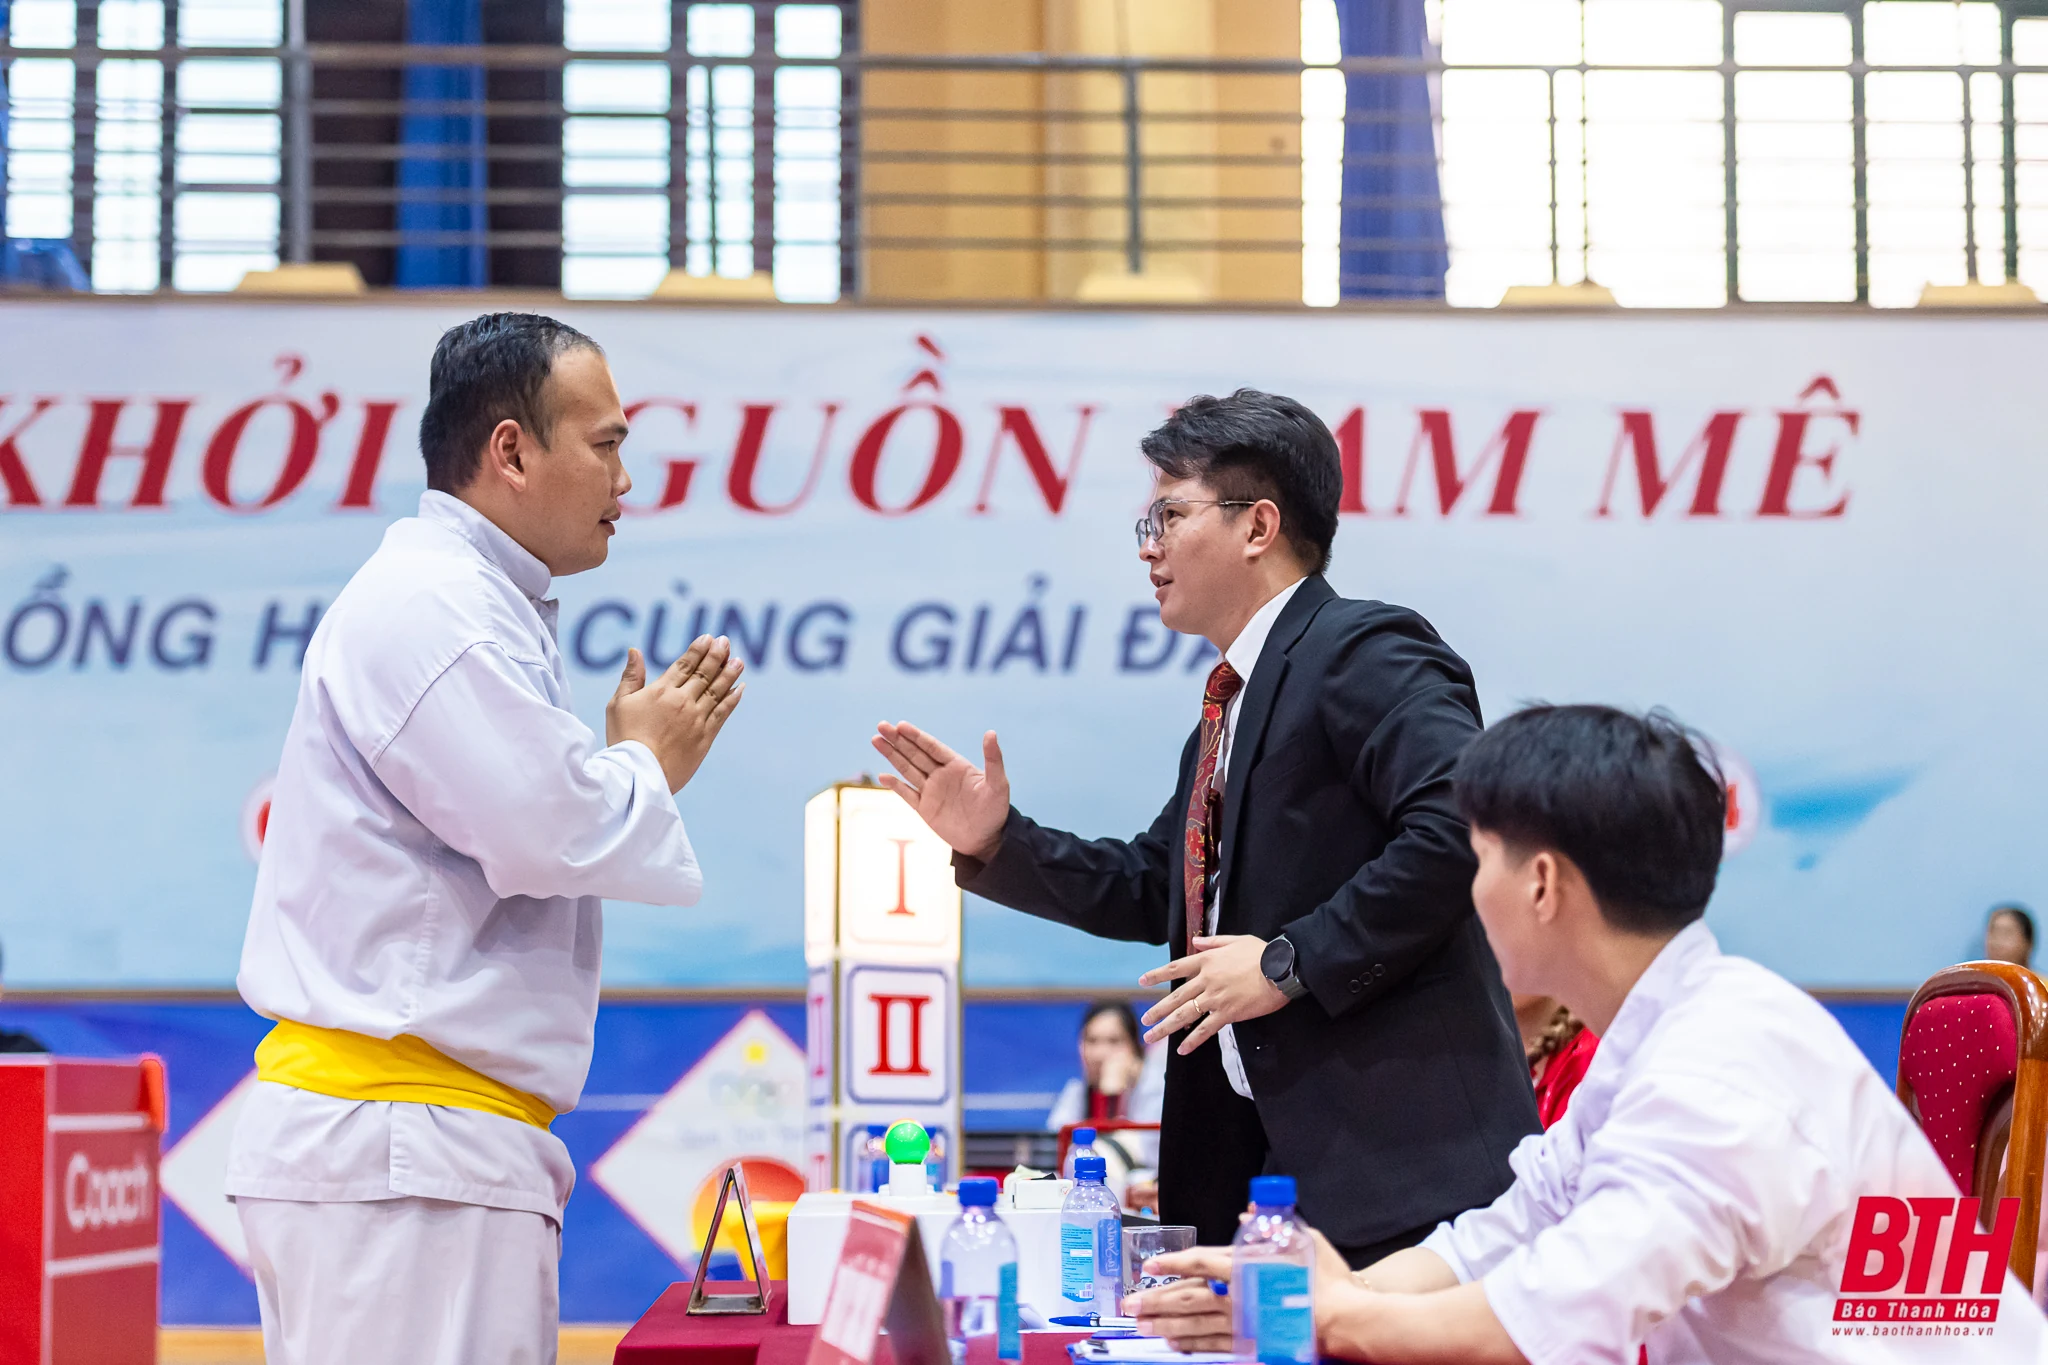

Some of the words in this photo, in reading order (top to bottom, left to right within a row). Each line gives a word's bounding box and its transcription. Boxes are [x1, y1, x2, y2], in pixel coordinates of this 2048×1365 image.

[618, 334, 1096, 517] GUỒN
[1587, 371, 1862, 520] MÊ
[571, 577, 853, 674] CÙNG
[890, 572, 1086, 675] GIẢI
